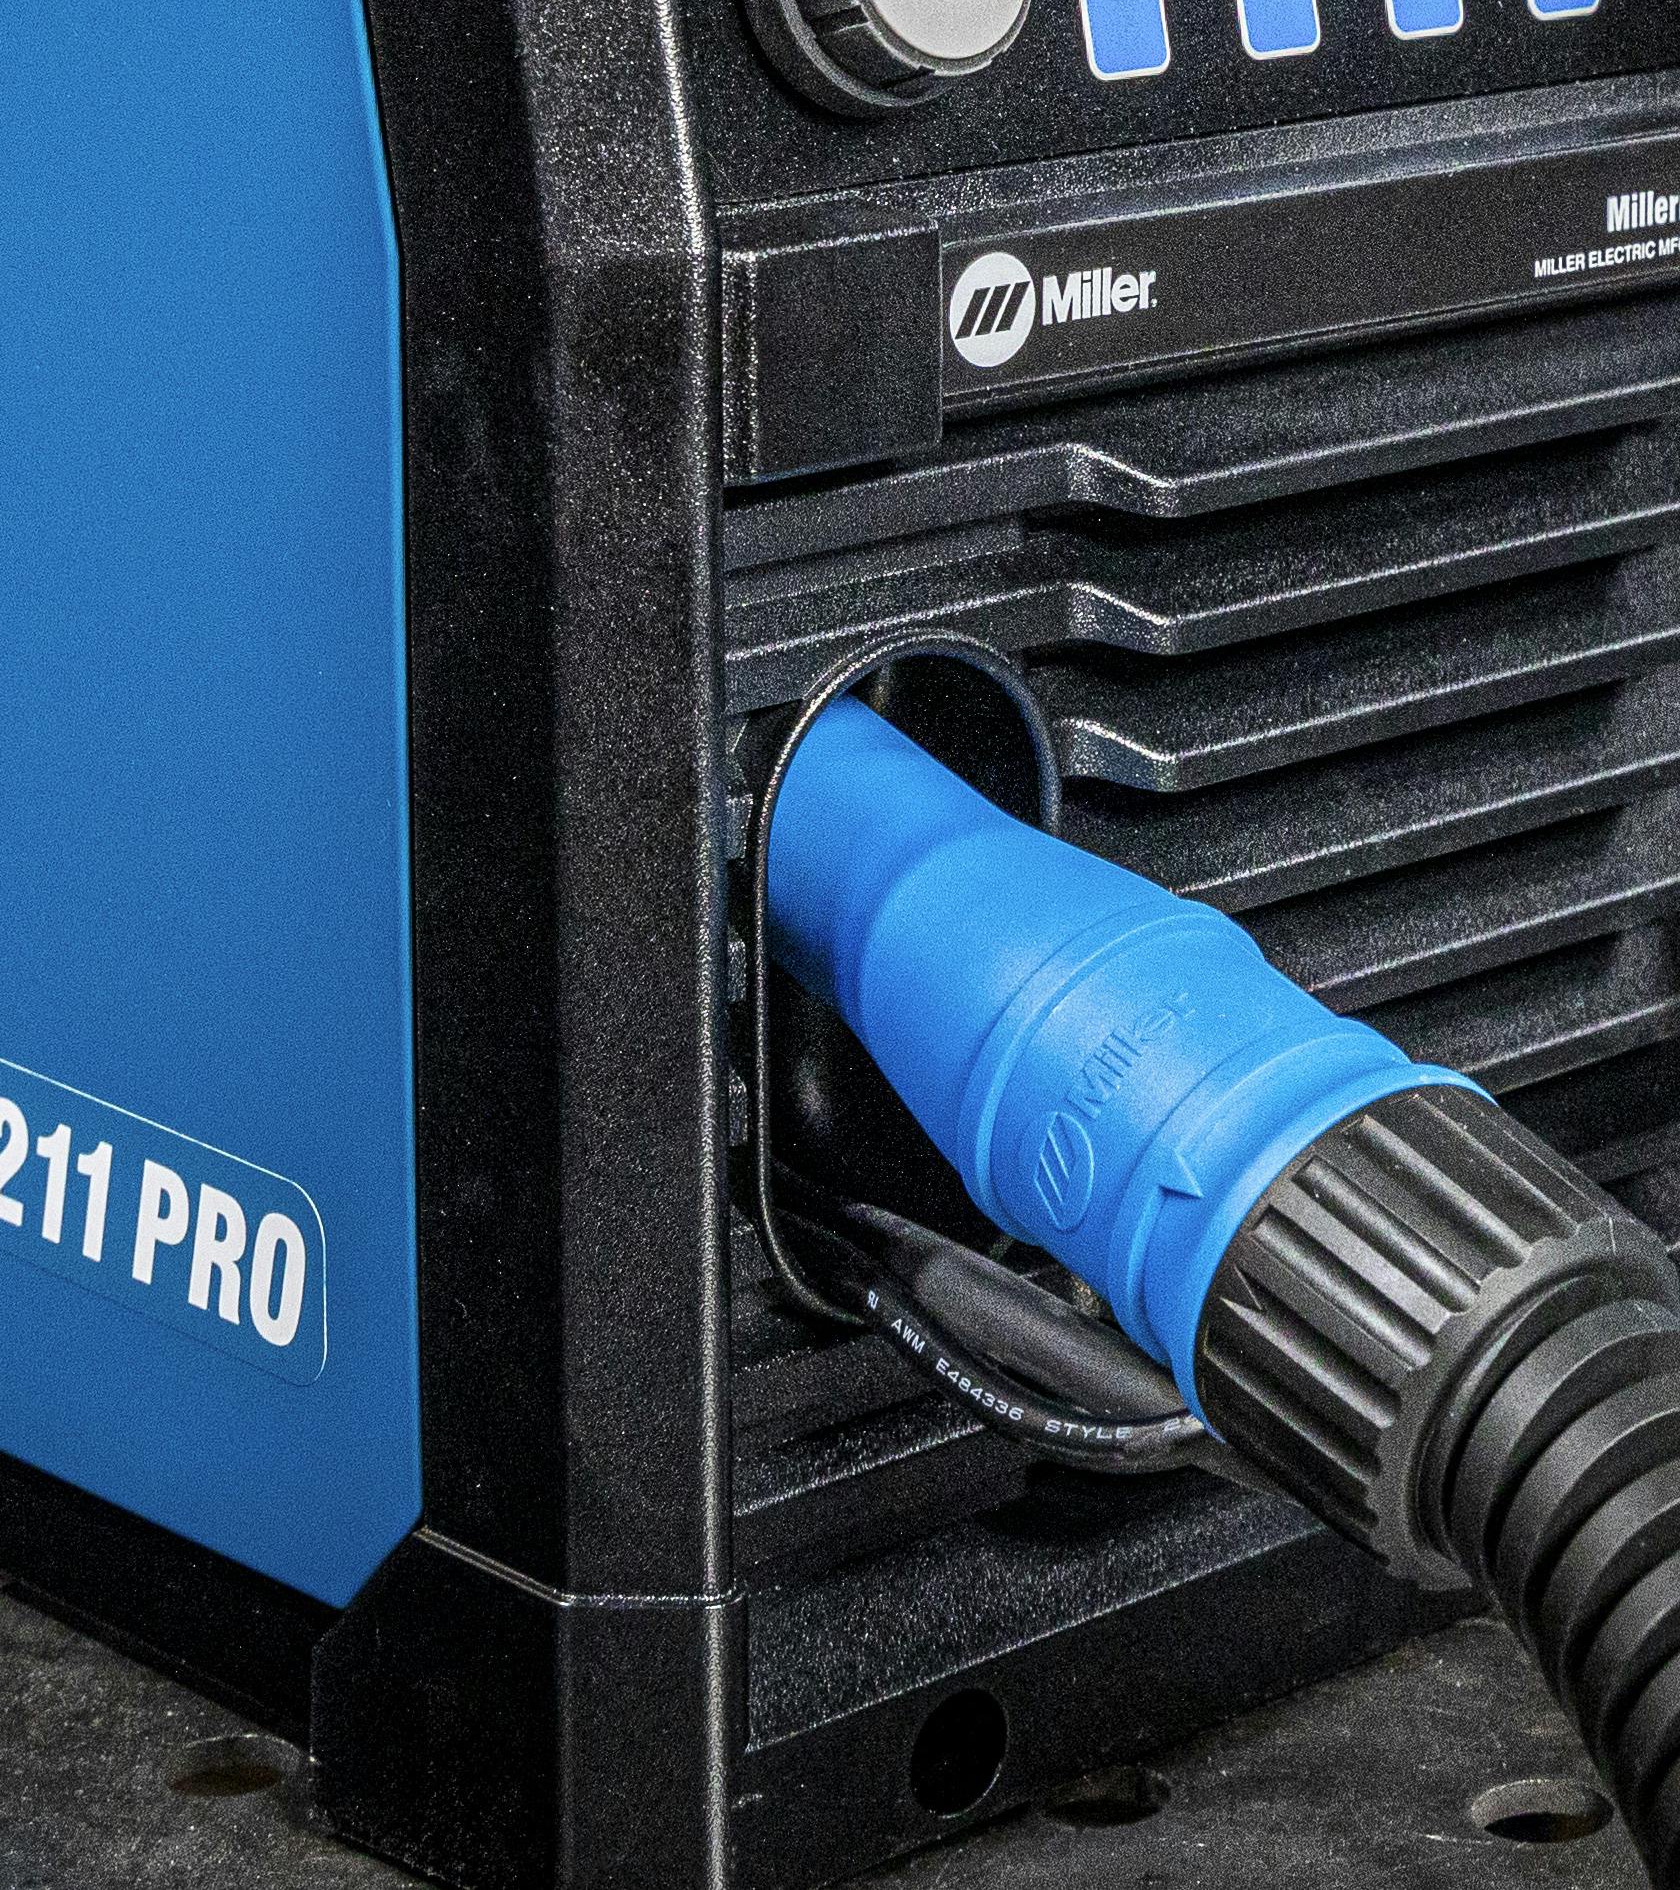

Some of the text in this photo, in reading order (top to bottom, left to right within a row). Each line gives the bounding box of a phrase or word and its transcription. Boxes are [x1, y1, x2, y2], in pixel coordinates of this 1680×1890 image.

[1534, 253, 1585, 278] MILLER
[1588, 241, 1656, 269] ELECTRIC
[132, 1160, 307, 1348] PRO
[891, 1318, 926, 1354] AWM
[935, 1357, 1024, 1421] E484336
[1044, 1419, 1134, 1441] STYLE
